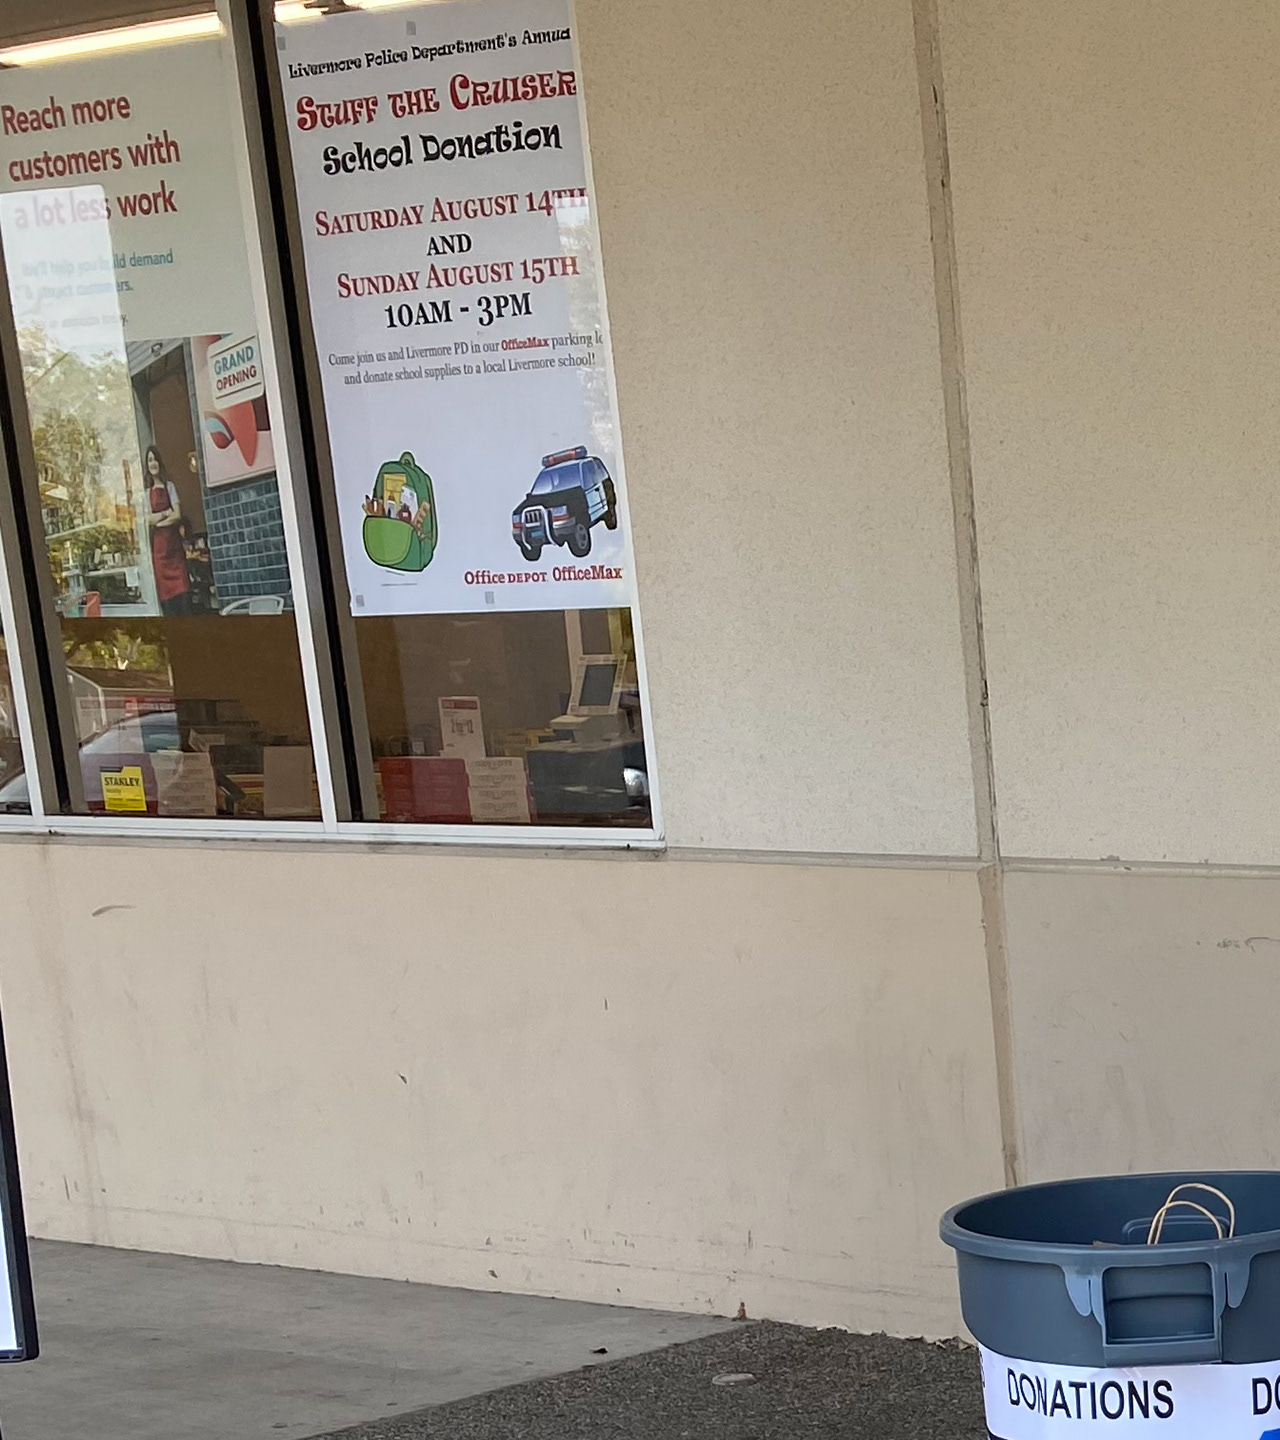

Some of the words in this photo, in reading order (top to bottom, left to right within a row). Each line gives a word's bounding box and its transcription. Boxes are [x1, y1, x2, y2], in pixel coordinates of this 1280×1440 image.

[288, 57, 362, 79] Livermore
[365, 49, 408, 68] Police
[411, 33, 516, 63] Department's
[1, 95, 66, 136] Reach
[71, 95, 131, 125] more
[296, 95, 378, 131] STUFF
[450, 71, 577, 110] CRUISER
[8, 147, 123, 182] customers
[127, 129, 181, 167] with
[323, 134, 413, 176] School
[419, 121, 563, 163] Donation
[117, 180, 178, 218] work
[315, 205, 424, 236] SATURDAY
[430, 193, 519, 223] AUGUST
[426, 233, 472, 256] AND
[337, 271, 420, 298] SUNDAY
[426, 262, 514, 290] AUGUST
[520, 255, 580, 284] 15TH
[384, 300, 453, 329] 10AM
[477, 292, 533, 327] 3PM
[214, 346, 254, 375] GRAND
[216, 365, 257, 390] OPENING
[464, 570, 505, 584] Office
[507, 572, 548, 583] DEPOT
[553, 565, 623, 581] OfficeMax
[1006, 1368, 1175, 1420] DONATIONS
